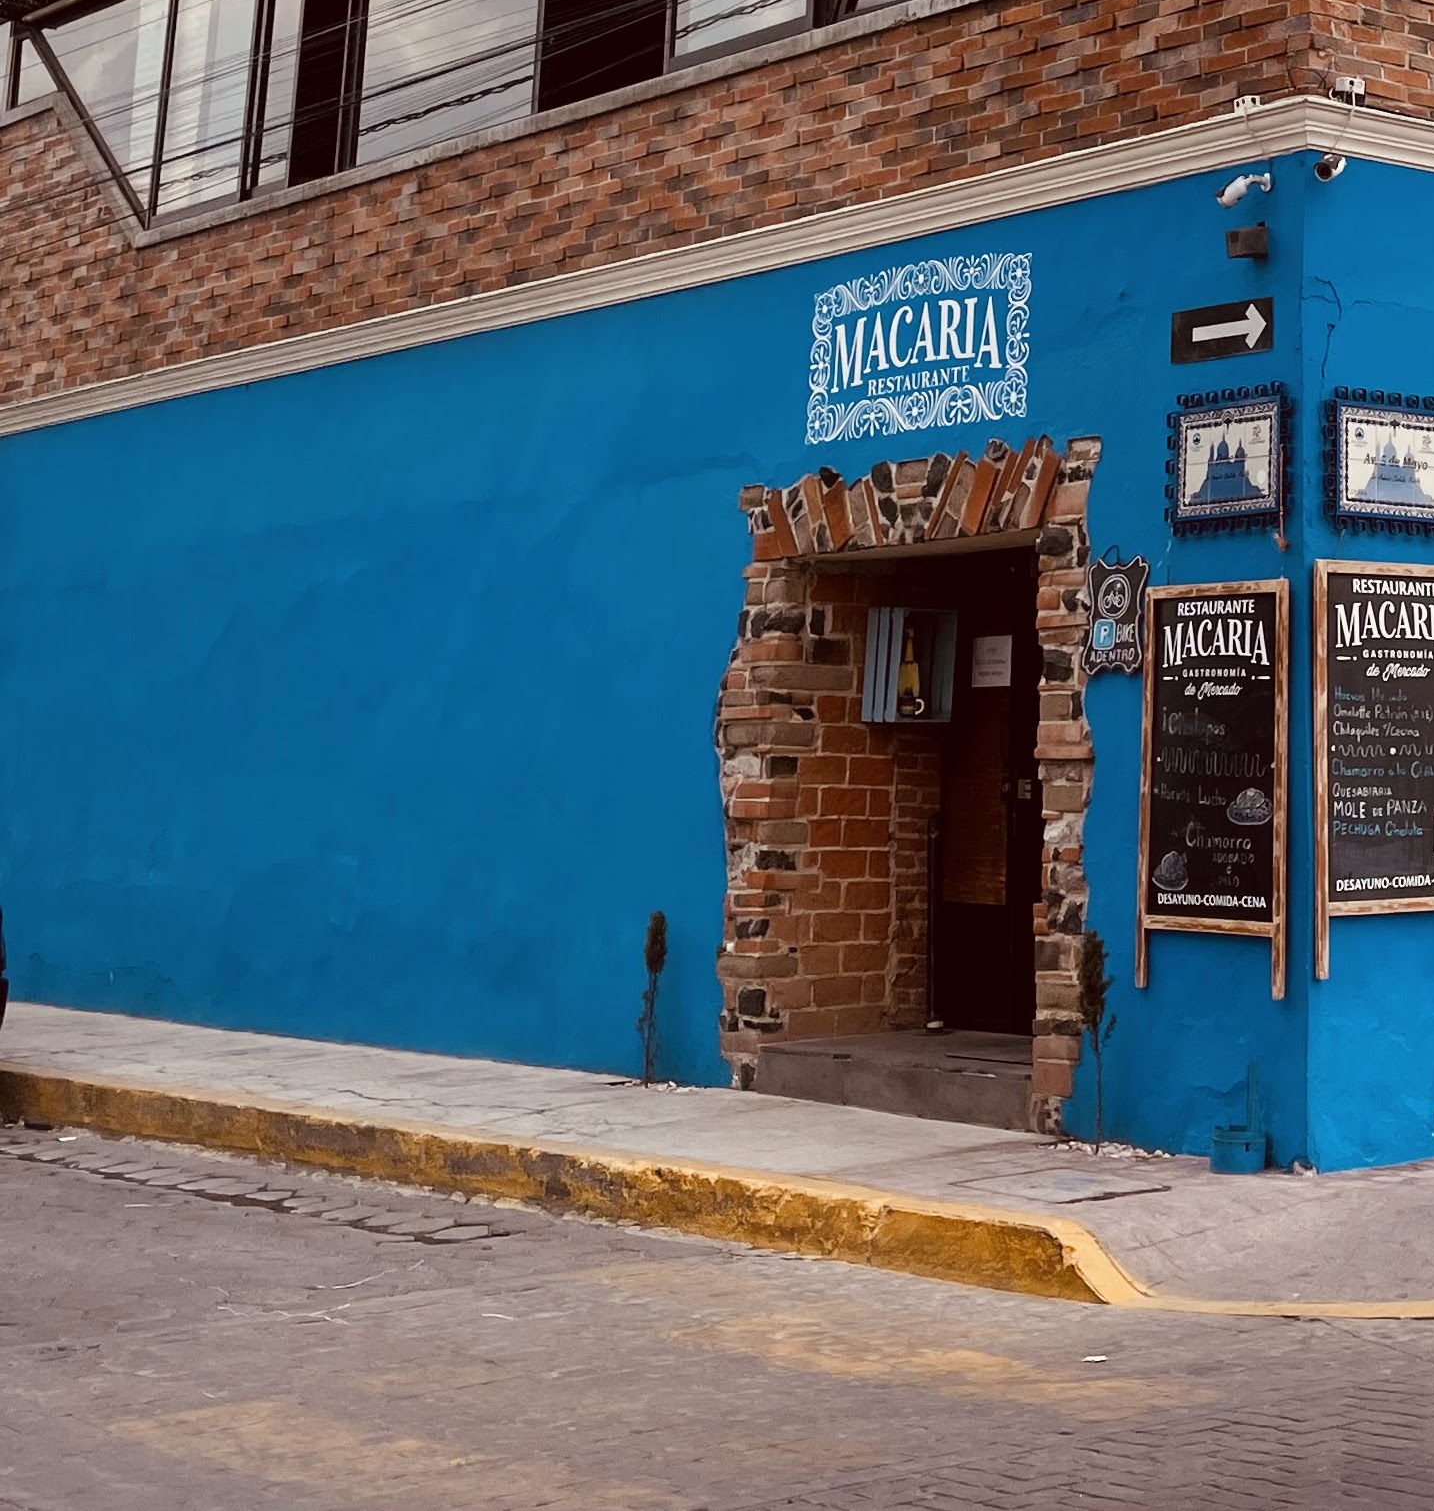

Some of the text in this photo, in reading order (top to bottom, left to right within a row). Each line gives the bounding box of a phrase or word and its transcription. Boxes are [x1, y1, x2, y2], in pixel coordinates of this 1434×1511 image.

[830, 295, 1003, 394] MACARIA
[866, 365, 971, 397] RESTAURANTE
[1403, 457, 1428, 472] Mayo
[1177, 599, 1255, 617] RESTAURANTE
[1116, 623, 1135, 643] BIKE
[1162, 618, 1270, 668] MACARIA
[1090, 648, 1135, 662] ADENTRO
[1362, 649, 1434, 660] GASTRONOMÍA
[1182, 667, 1247, 677] GASTRONOMÍA
[1366, 662, 1431, 682] de Mercado
[1333, 800, 1367, 819] MOLE
[1386, 799, 1428, 817] PANZA
[1332, 820, 1382, 837] PECHUGA
[1157, 892, 1267, 909] DESAYUNO-COMIDA-CENA
